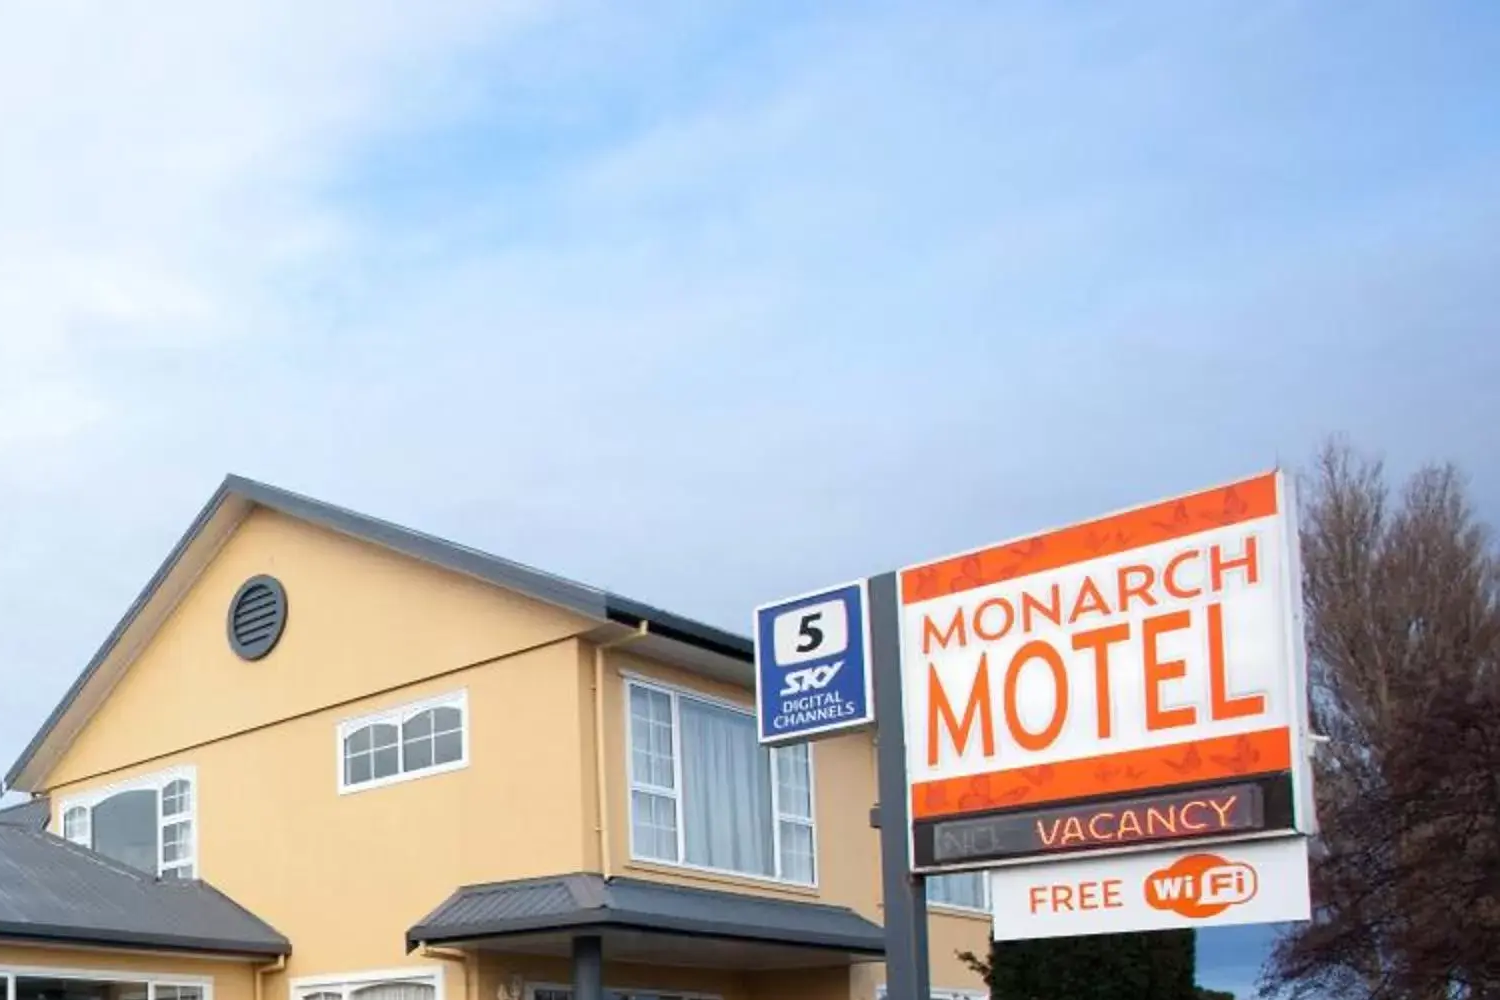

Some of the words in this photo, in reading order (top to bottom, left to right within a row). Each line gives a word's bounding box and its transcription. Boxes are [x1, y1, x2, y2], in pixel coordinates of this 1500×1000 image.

[922, 536, 1259, 655] MONARCH
[796, 612, 824, 652] 5
[783, 690, 844, 714] DIGITAL
[927, 603, 1266, 767] MOTEL
[773, 701, 855, 728] CHANNELS
[1037, 796, 1237, 845] VACANCY
[1029, 880, 1124, 914] FREE
